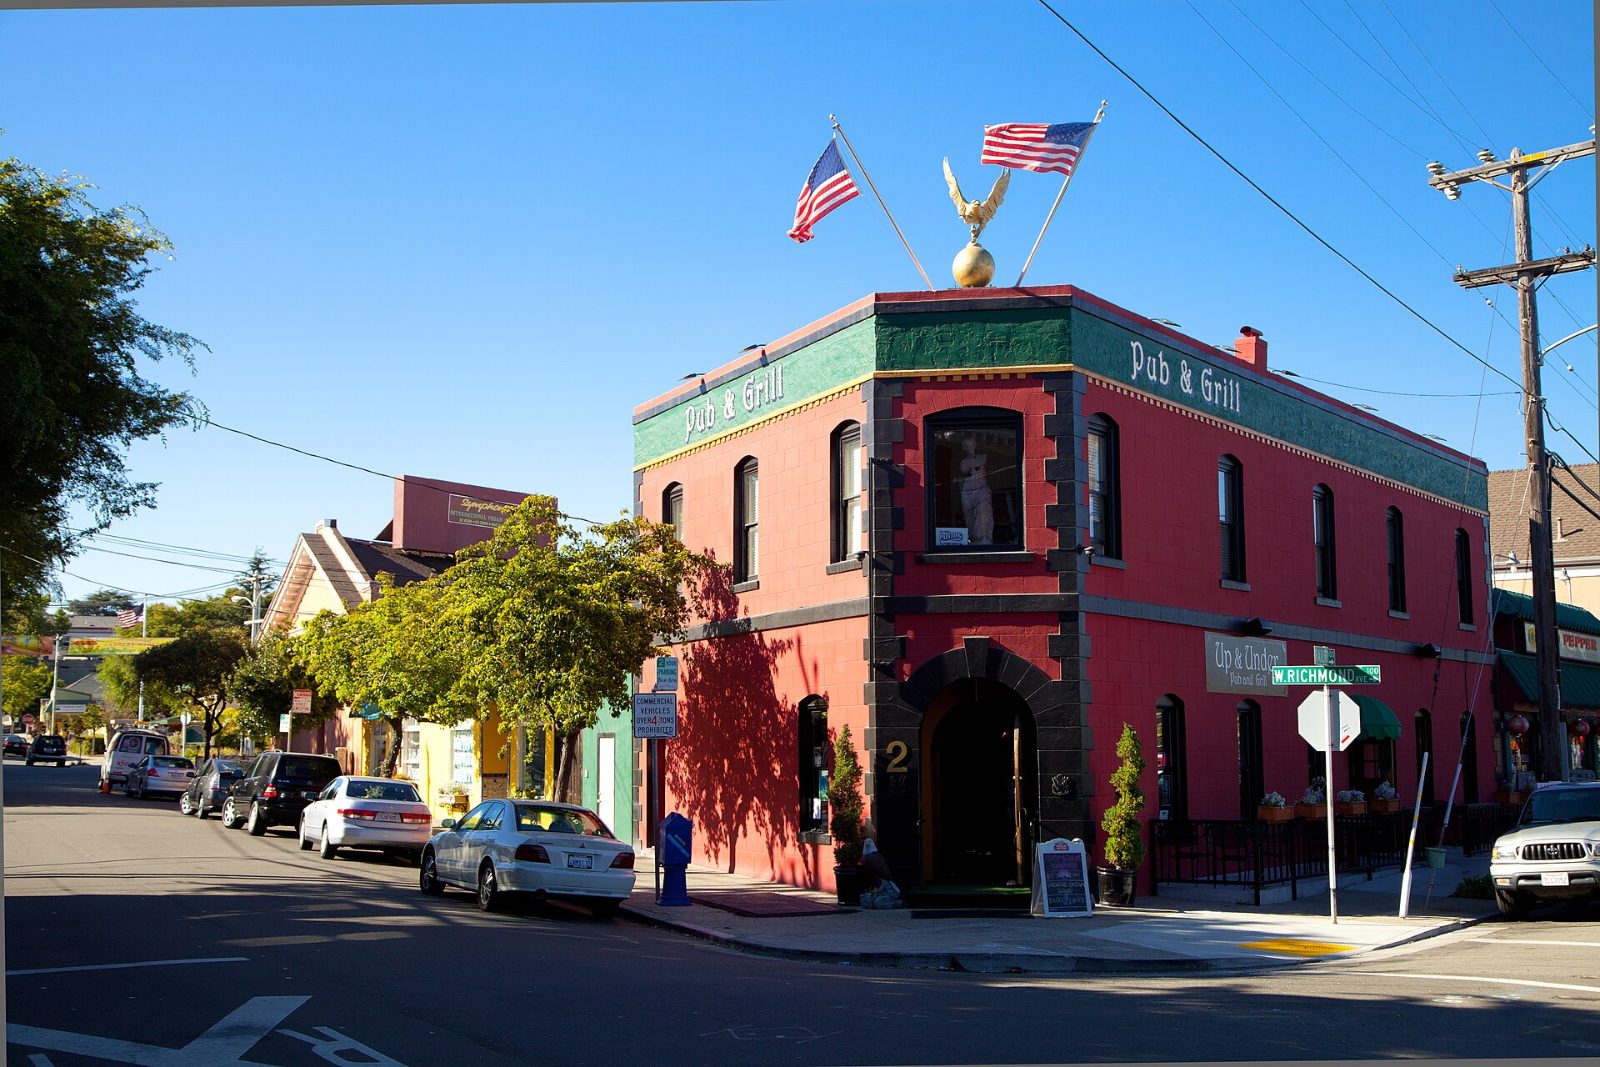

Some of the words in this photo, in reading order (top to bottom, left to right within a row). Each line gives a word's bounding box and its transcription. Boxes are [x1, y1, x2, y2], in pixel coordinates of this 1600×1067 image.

[1130, 340, 1169, 386] Pub
[1180, 359, 1193, 395] &
[1201, 368, 1240, 413] Grill
[684, 396, 716, 444] Pub
[723, 386, 736, 421] &
[742, 362, 784, 413] Grill
[460, 498, 510, 513] Sympho
[1563, 633, 1597, 652] PEPPER
[1215, 641, 1232, 674] Up
[1234, 647, 1243, 670] &
[1245, 644, 1279, 673] Under
[1230, 671, 1242, 686] Pub
[1242, 674, 1254, 686] and
[1255, 673, 1268, 687] Grill
[1356, 675, 1367, 683] AVE
[1366, 667, 1379, 675] 100
[636, 716, 652, 724] OVER
[650, 715, 657, 726] 4
[660, 716, 674, 724] TONS
[886, 740, 908, 773] 2
